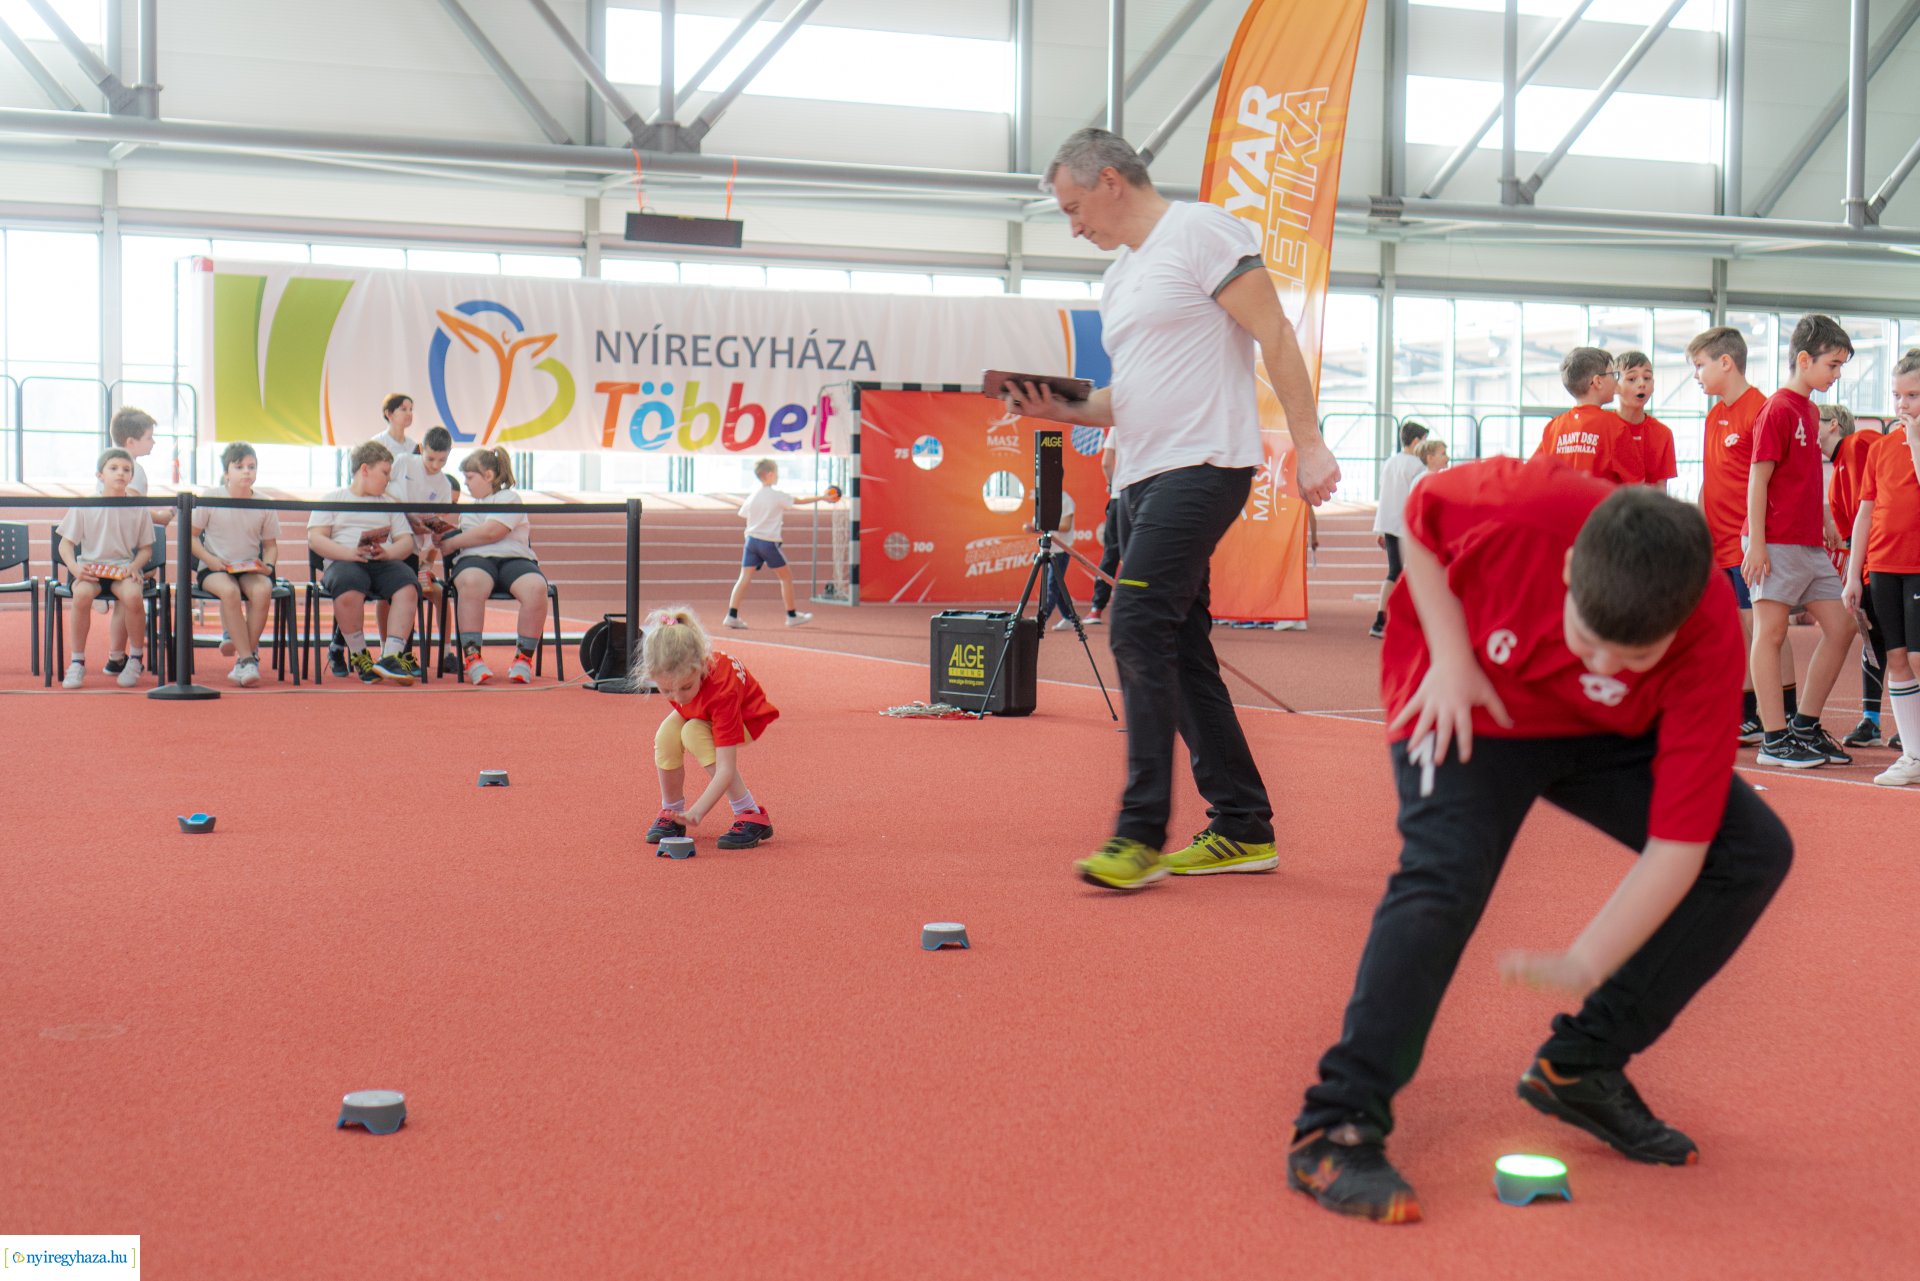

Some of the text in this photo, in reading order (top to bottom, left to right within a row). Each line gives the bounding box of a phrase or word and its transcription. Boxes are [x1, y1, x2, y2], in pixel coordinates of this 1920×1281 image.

[595, 324, 877, 371] NYÍREGYHÁZA
[594, 380, 838, 453] Többet
[987, 435, 1019, 447] MASZ
[1041, 436, 1062, 447] ALGE
[1794, 417, 1807, 447] 4
[913, 541, 934, 553] 100
[948, 643, 984, 669] ALGE
[1486, 628, 1517, 664] 6
